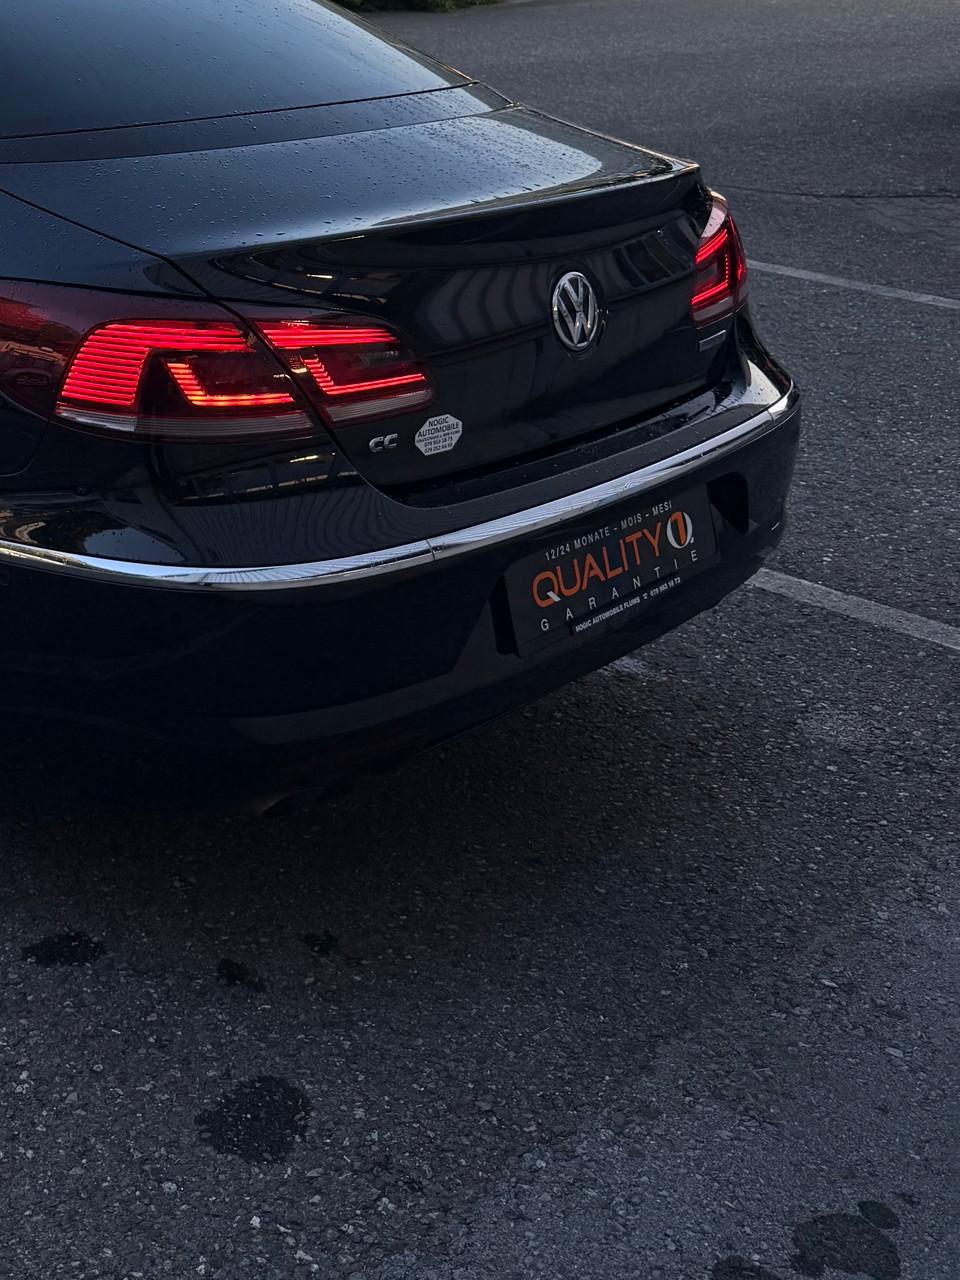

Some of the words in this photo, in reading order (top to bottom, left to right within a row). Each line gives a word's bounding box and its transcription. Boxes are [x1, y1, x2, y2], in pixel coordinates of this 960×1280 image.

[417, 421, 460, 438] AUTOMOBILE
[428, 416, 449, 428] NOGIC
[368, 433, 398, 453] CC
[545, 542, 571, 561] 12/24
[574, 526, 611, 549] MONATE
[621, 513, 642, 531] MOIS
[652, 499, 673, 516] MESI
[532, 522, 662, 608] QUALITY
[541, 550, 698, 631] GARANTIE
[575, 619, 592, 633] NOGIC
[592, 604, 624, 625] AUTOMOBILE
